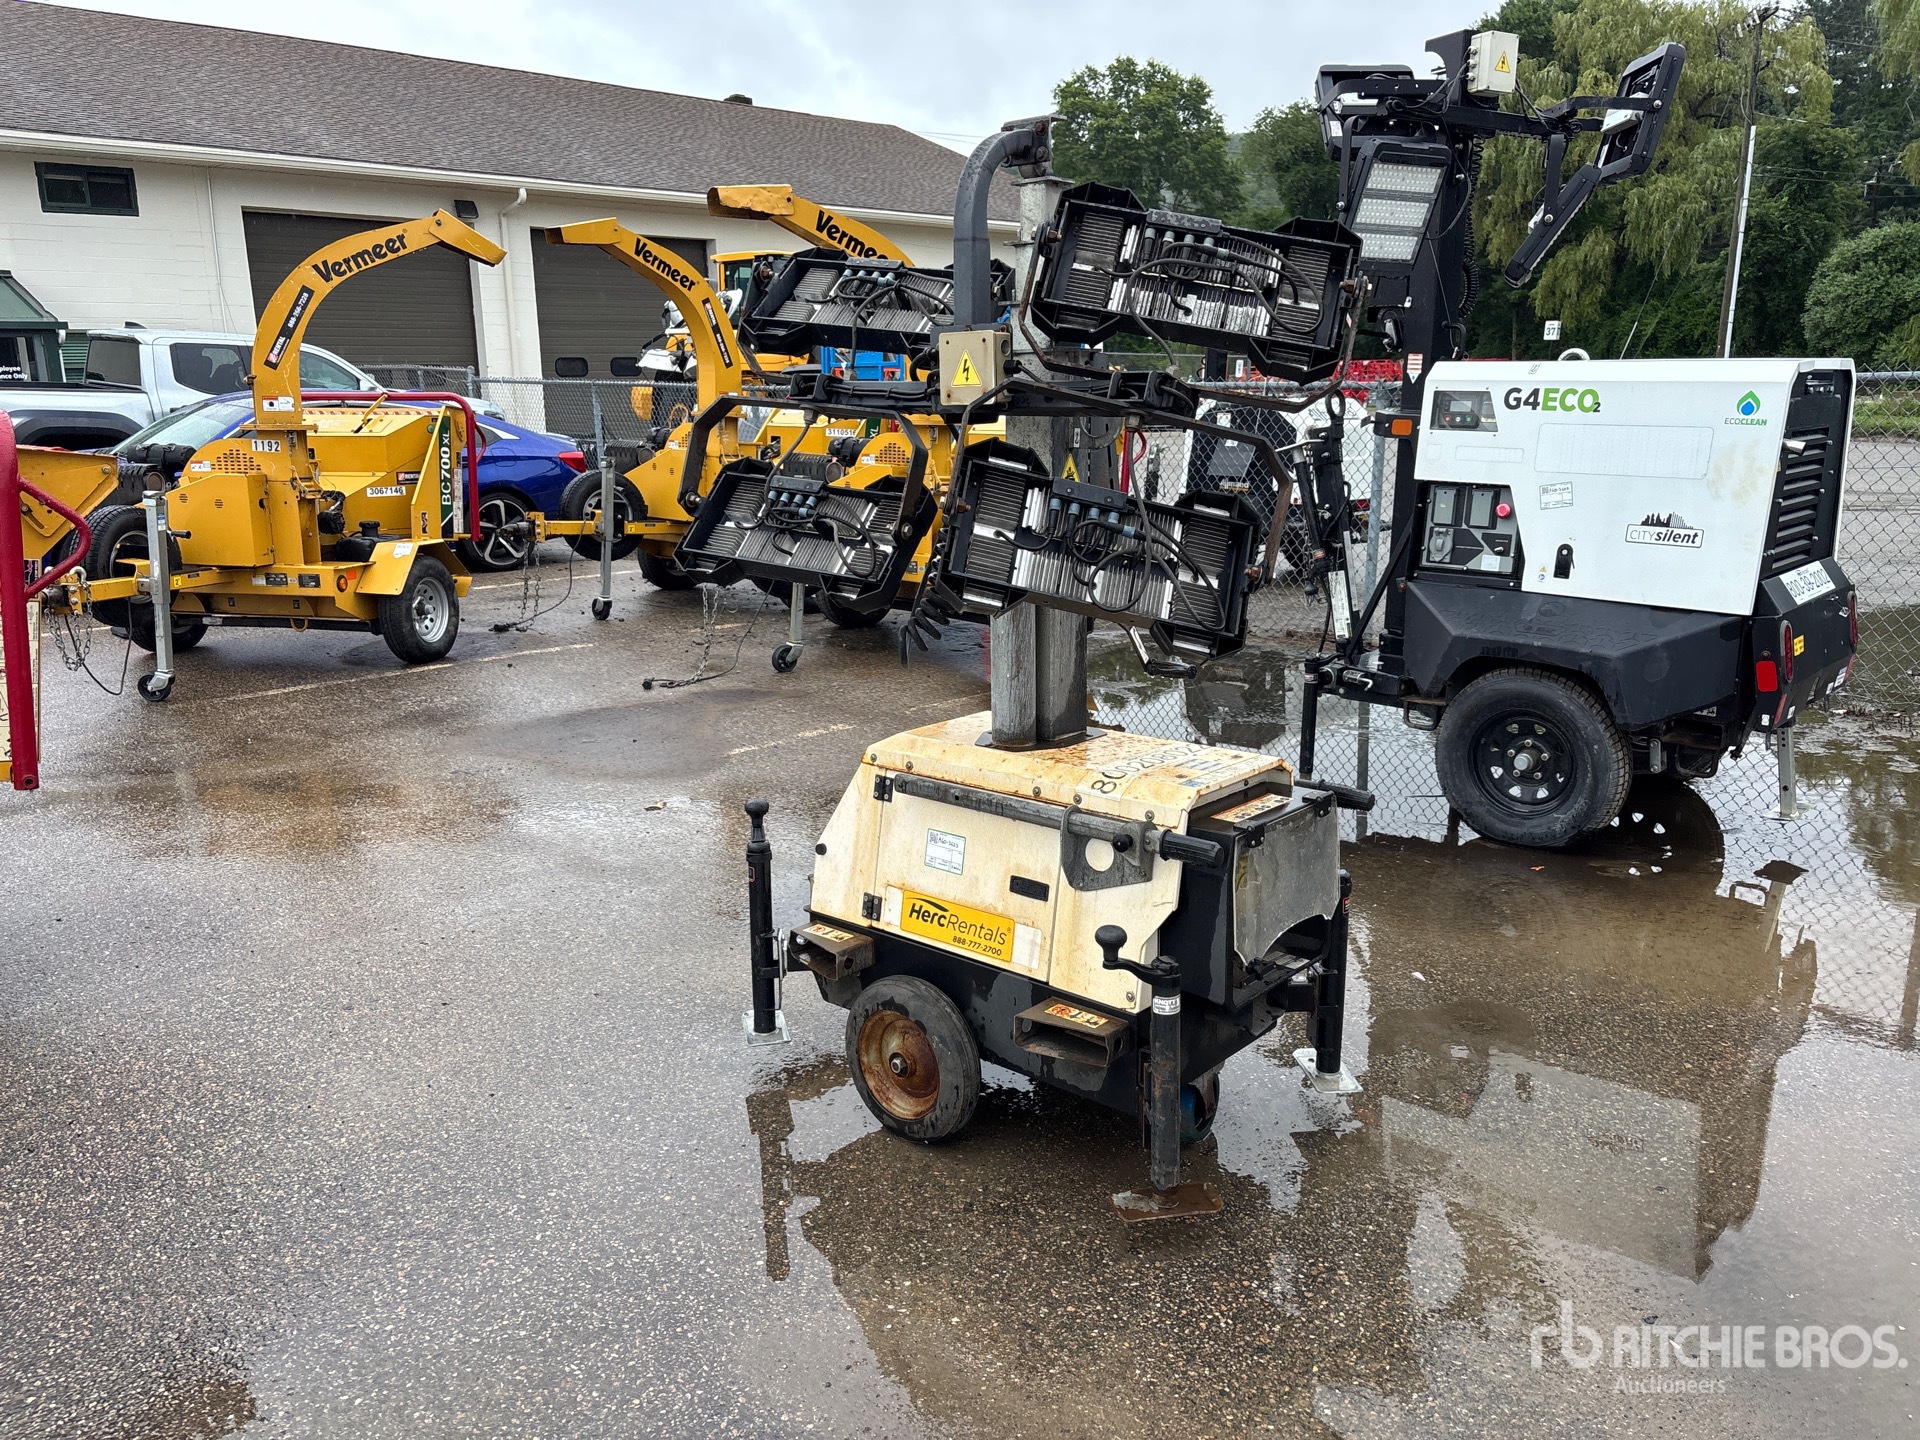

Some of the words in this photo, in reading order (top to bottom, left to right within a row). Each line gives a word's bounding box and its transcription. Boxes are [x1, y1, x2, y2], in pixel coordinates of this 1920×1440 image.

[815, 209, 889, 259] Verme
[311, 232, 408, 283] Vermeer
[633, 237, 697, 292] Vermeer
[1724, 417, 1768, 426] ECOCLEAN
[253, 440, 280, 452] 1192
[369, 486, 404, 495] 3067146
[952, 935, 1002, 956] 888-777-2700
